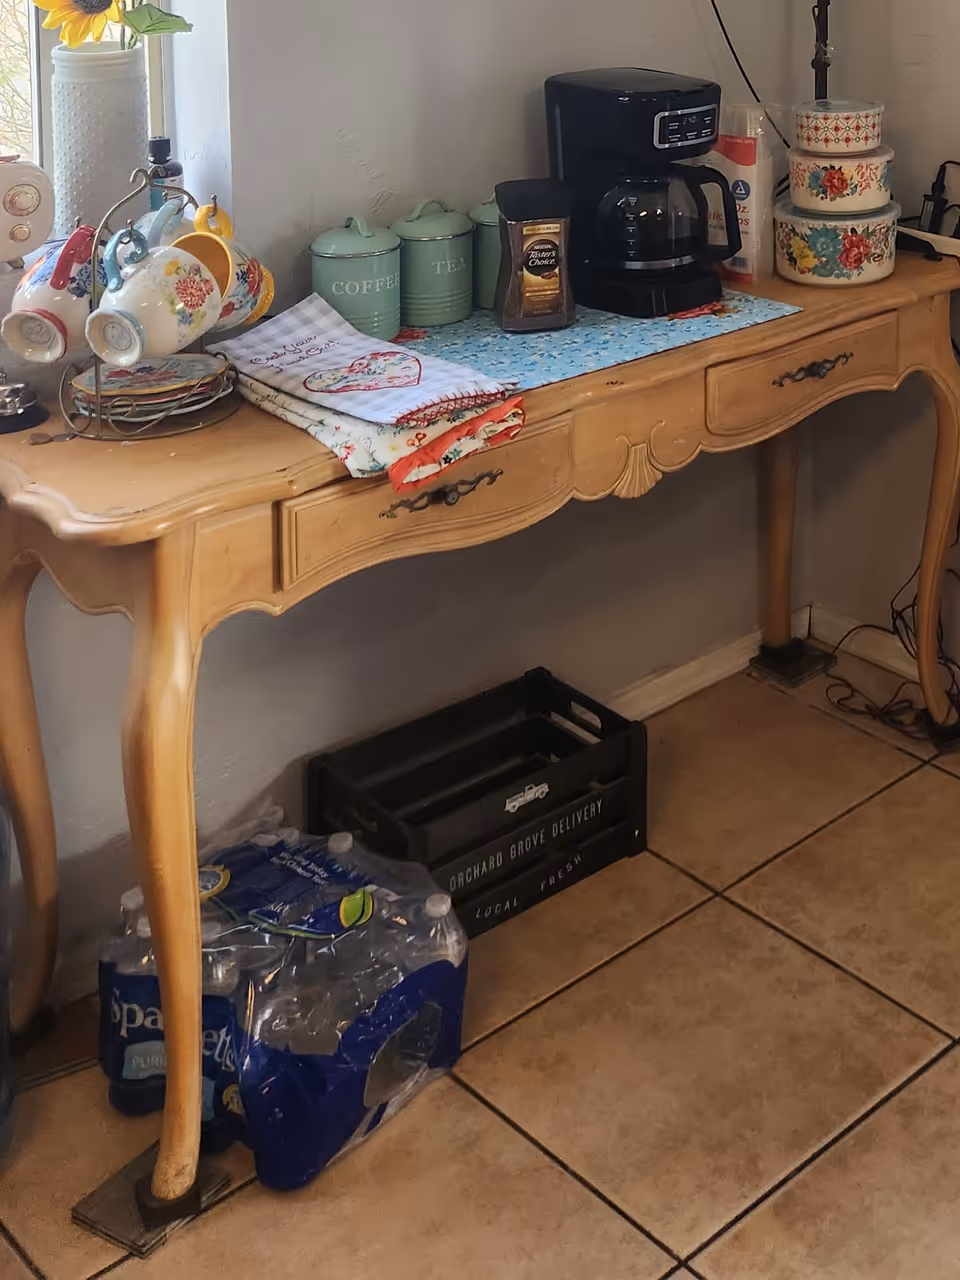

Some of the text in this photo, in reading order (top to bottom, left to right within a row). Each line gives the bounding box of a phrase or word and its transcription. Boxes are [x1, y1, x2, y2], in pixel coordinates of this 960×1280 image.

[432, 258, 466, 274] TEA
[450, 799, 603, 891] ORCHARD GROVE DELIVERY
[476, 854, 582, 919] LOCAL FRESH
